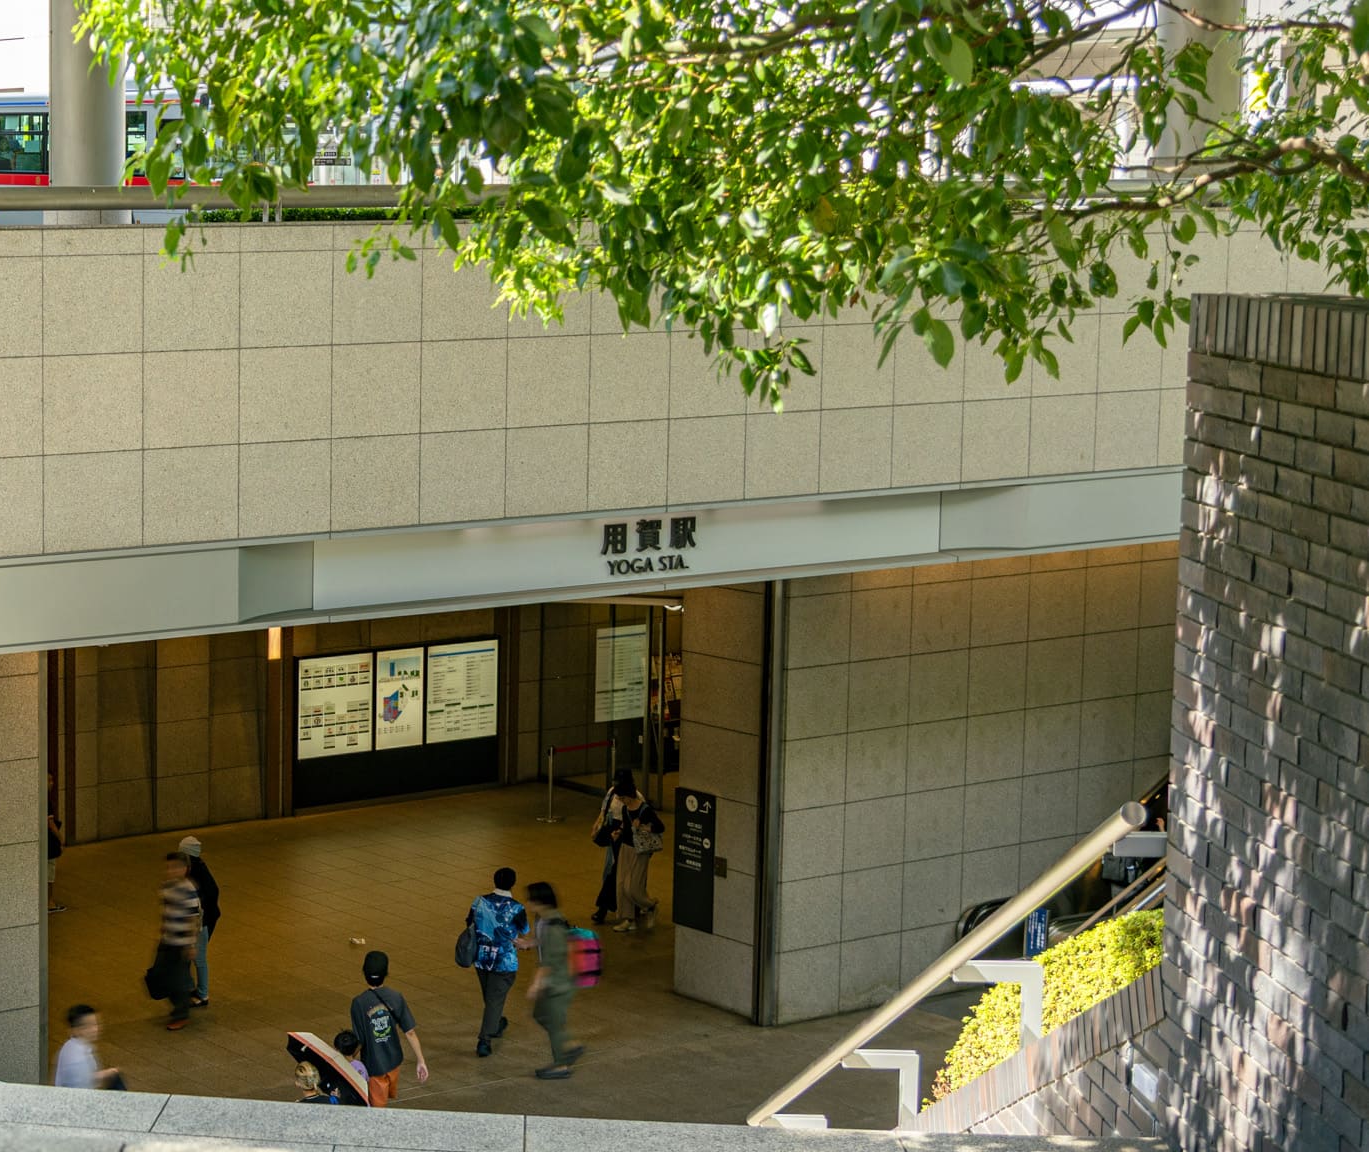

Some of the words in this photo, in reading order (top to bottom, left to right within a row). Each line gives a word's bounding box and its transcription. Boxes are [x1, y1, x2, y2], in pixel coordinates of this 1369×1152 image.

[600, 516, 697, 556] 用賀駅
[607, 557, 654, 576] YOGA
[658, 554, 690, 572] STA.
